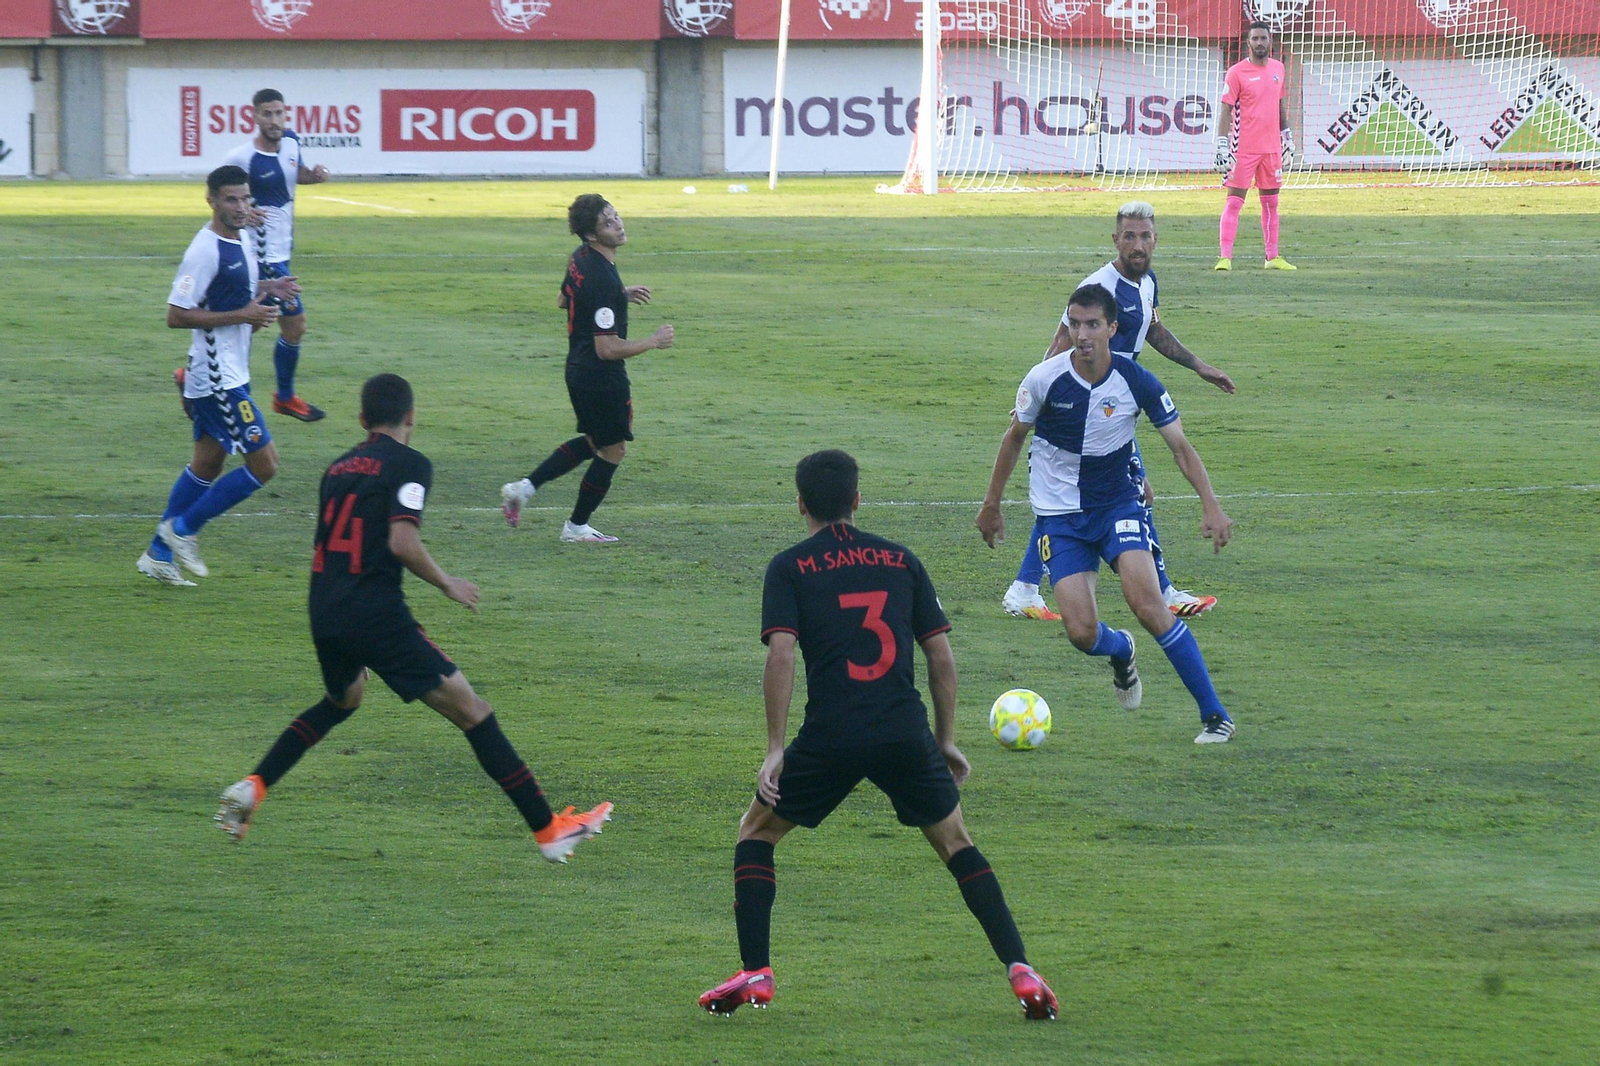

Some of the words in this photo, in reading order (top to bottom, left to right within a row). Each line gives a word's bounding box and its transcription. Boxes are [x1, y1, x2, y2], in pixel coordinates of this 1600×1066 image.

[186, 90, 197, 152] DIGITALES
[208, 104, 361, 134] SISEMAS
[400, 107, 578, 141] RICOH
[1317, 84, 1381, 153] LEROY
[1374, 68, 1459, 151] MERLIN
[1480, 80, 1543, 150] LEROY
[238, 400, 255, 423] 8
[797, 555, 822, 574] M.
[824, 547, 907, 570] SANCHEZ
[838, 590, 897, 682] 3
